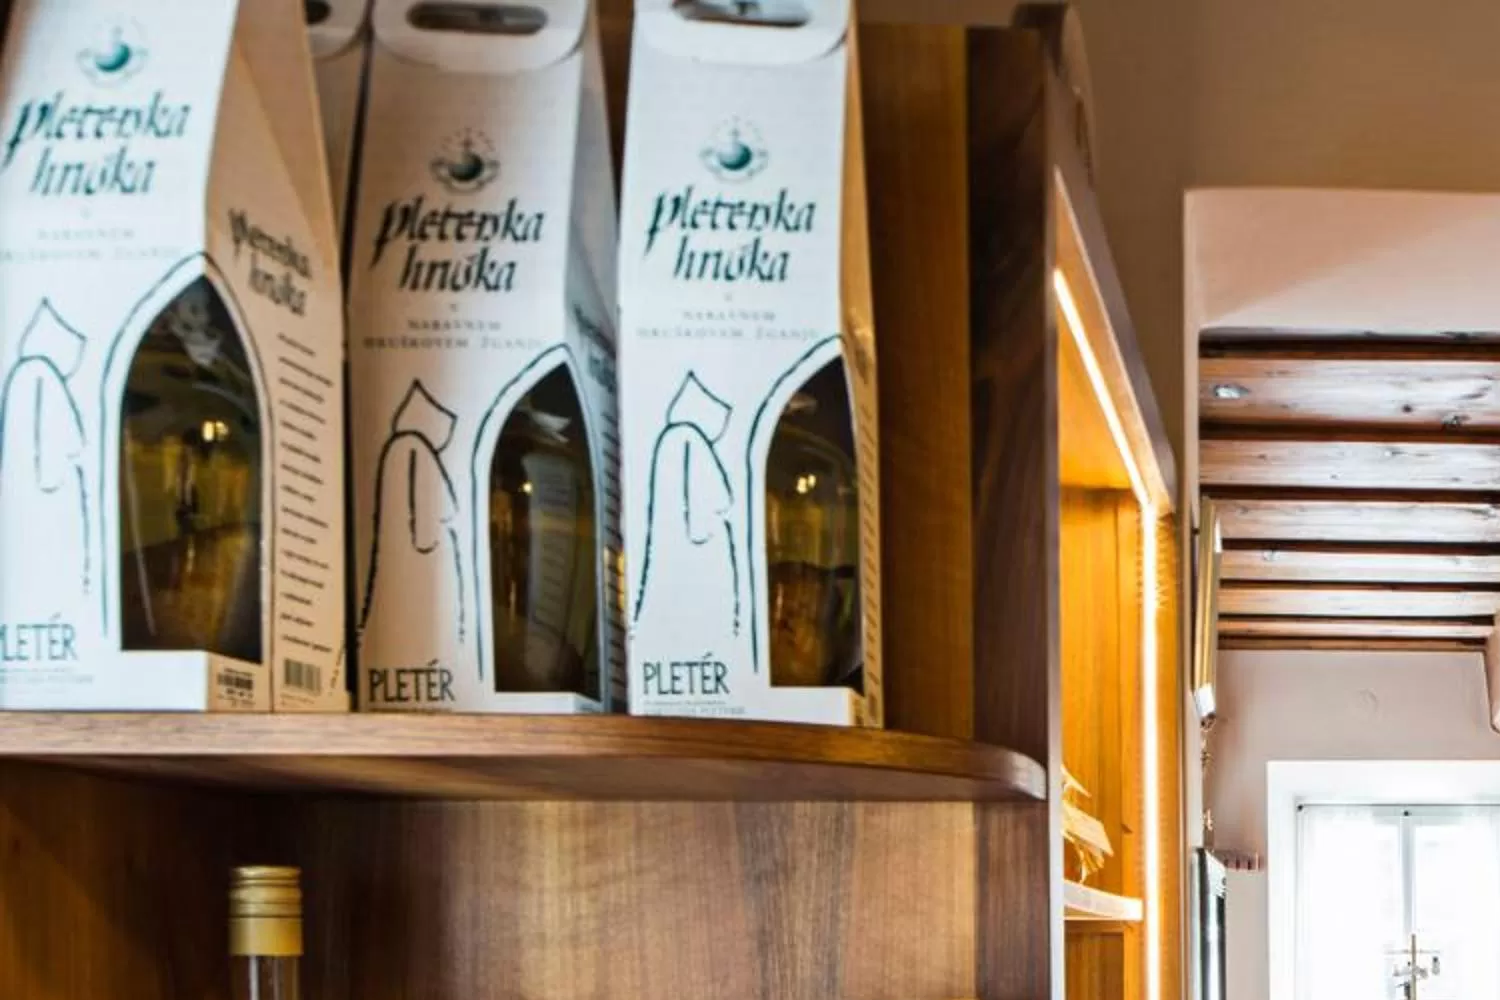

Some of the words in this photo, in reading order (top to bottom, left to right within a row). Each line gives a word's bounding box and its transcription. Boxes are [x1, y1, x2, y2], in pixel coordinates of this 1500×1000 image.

[0, 611, 80, 661] LETÉR
[368, 658, 456, 702] PLETÉR
[643, 652, 730, 695] PLETÉR
